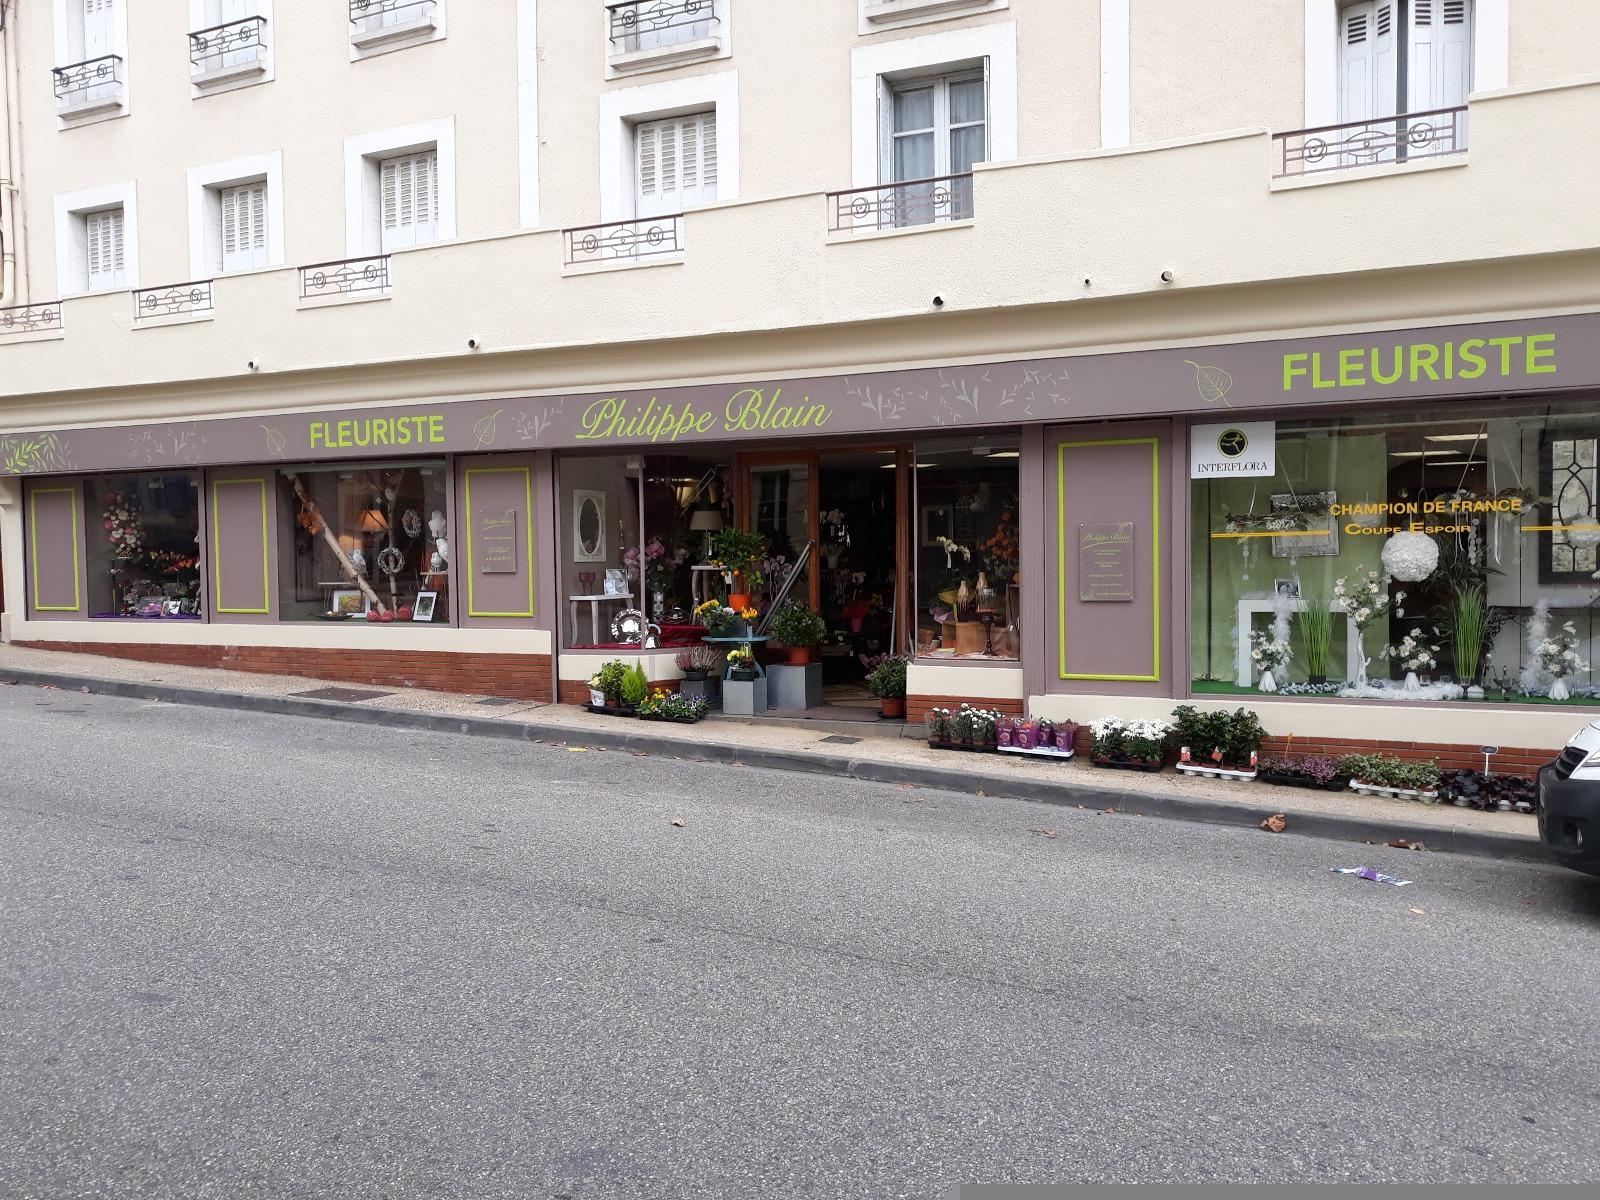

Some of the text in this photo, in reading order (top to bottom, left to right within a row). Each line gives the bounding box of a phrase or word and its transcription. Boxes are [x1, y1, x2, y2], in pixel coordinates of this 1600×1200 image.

[1282, 333, 1556, 391] FLEURISTE
[576, 388, 833, 441] Philippe Blain
[309, 415, 446, 448] FLEURISTE
[1197, 461, 1268, 473] INTERFLORA
[1330, 499, 1522, 516] CHAMPION DE FRANCE
